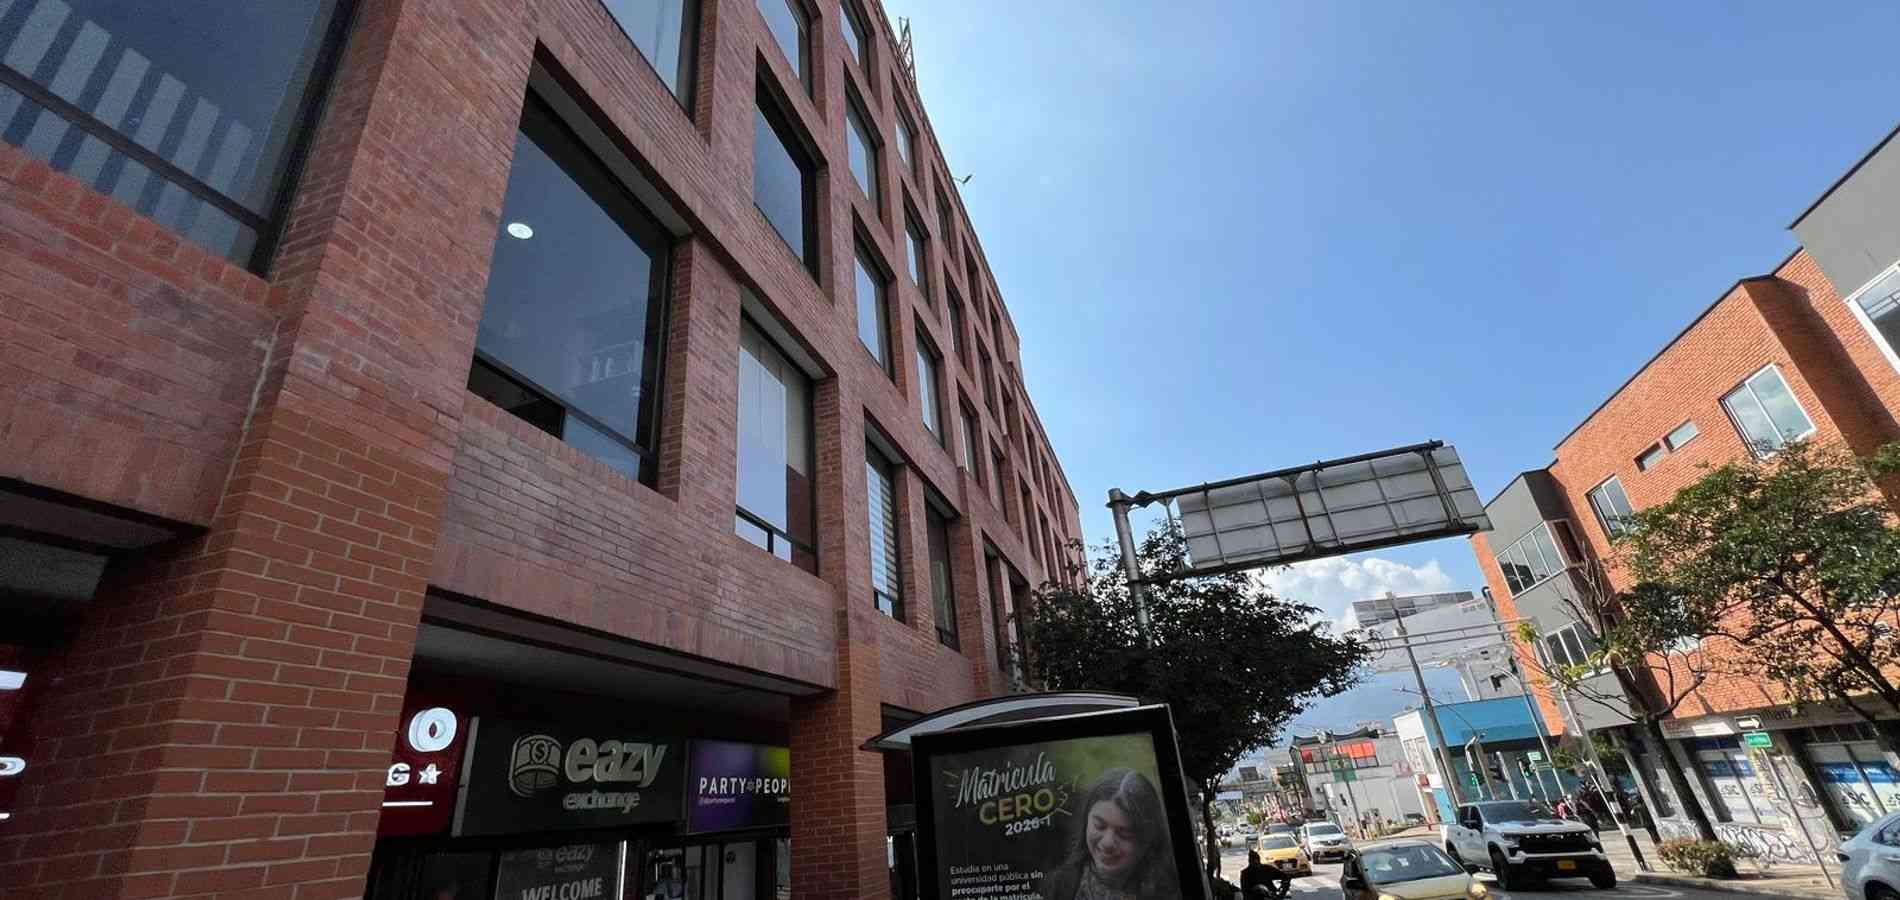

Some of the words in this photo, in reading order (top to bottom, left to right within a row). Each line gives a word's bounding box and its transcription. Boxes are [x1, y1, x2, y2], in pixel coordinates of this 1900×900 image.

[565, 738, 668, 788] eazy
[699, 777, 746, 794] PARTY
[562, 789, 640, 814] exchange
[979, 788, 1055, 825] CERO
[994, 863, 1009, 871] una
[1030, 869, 1044, 879] sin
[521, 877, 603, 900] WELCOME
[1005, 883, 1020, 893] por
[1021, 881, 1031, 890] el
